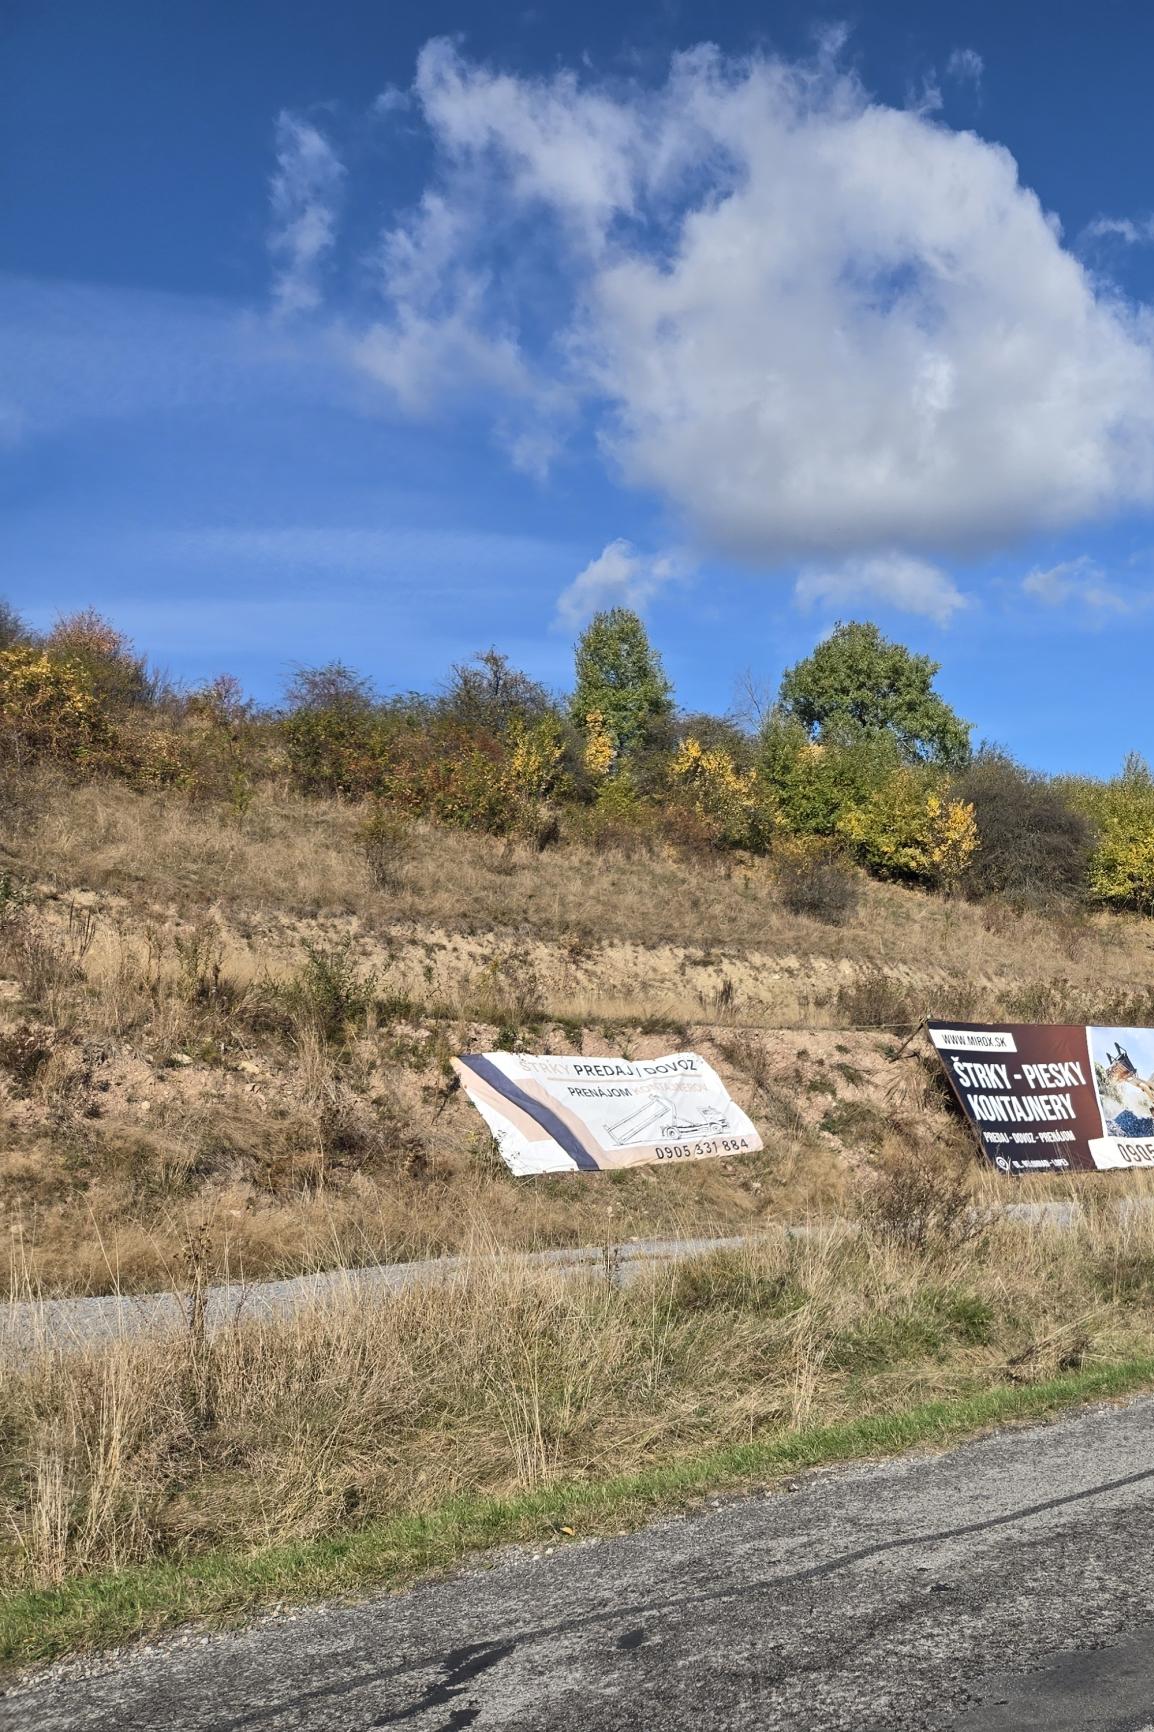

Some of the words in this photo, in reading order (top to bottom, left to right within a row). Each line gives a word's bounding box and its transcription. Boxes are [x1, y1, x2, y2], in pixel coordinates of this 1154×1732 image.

[941, 1034, 1008, 1048] WWW.MIROX.SK
[573, 1064, 634, 1077] PREDAJ
[644, 1059, 698, 1075] DOVOZ
[950, 1056, 1012, 1090] ŠTRKY
[1021, 1061, 1087, 1089] PIESKY
[567, 1086, 633, 1098] PRENÁJOM
[966, 1093, 1077, 1122] KONTAJNERY
[982, 1131, 1010, 1143] PREDAJ
[655, 1143, 691, 1160] 0905
[695, 1141, 718, 1155] 331
[721, 1138, 749, 1151] 884
